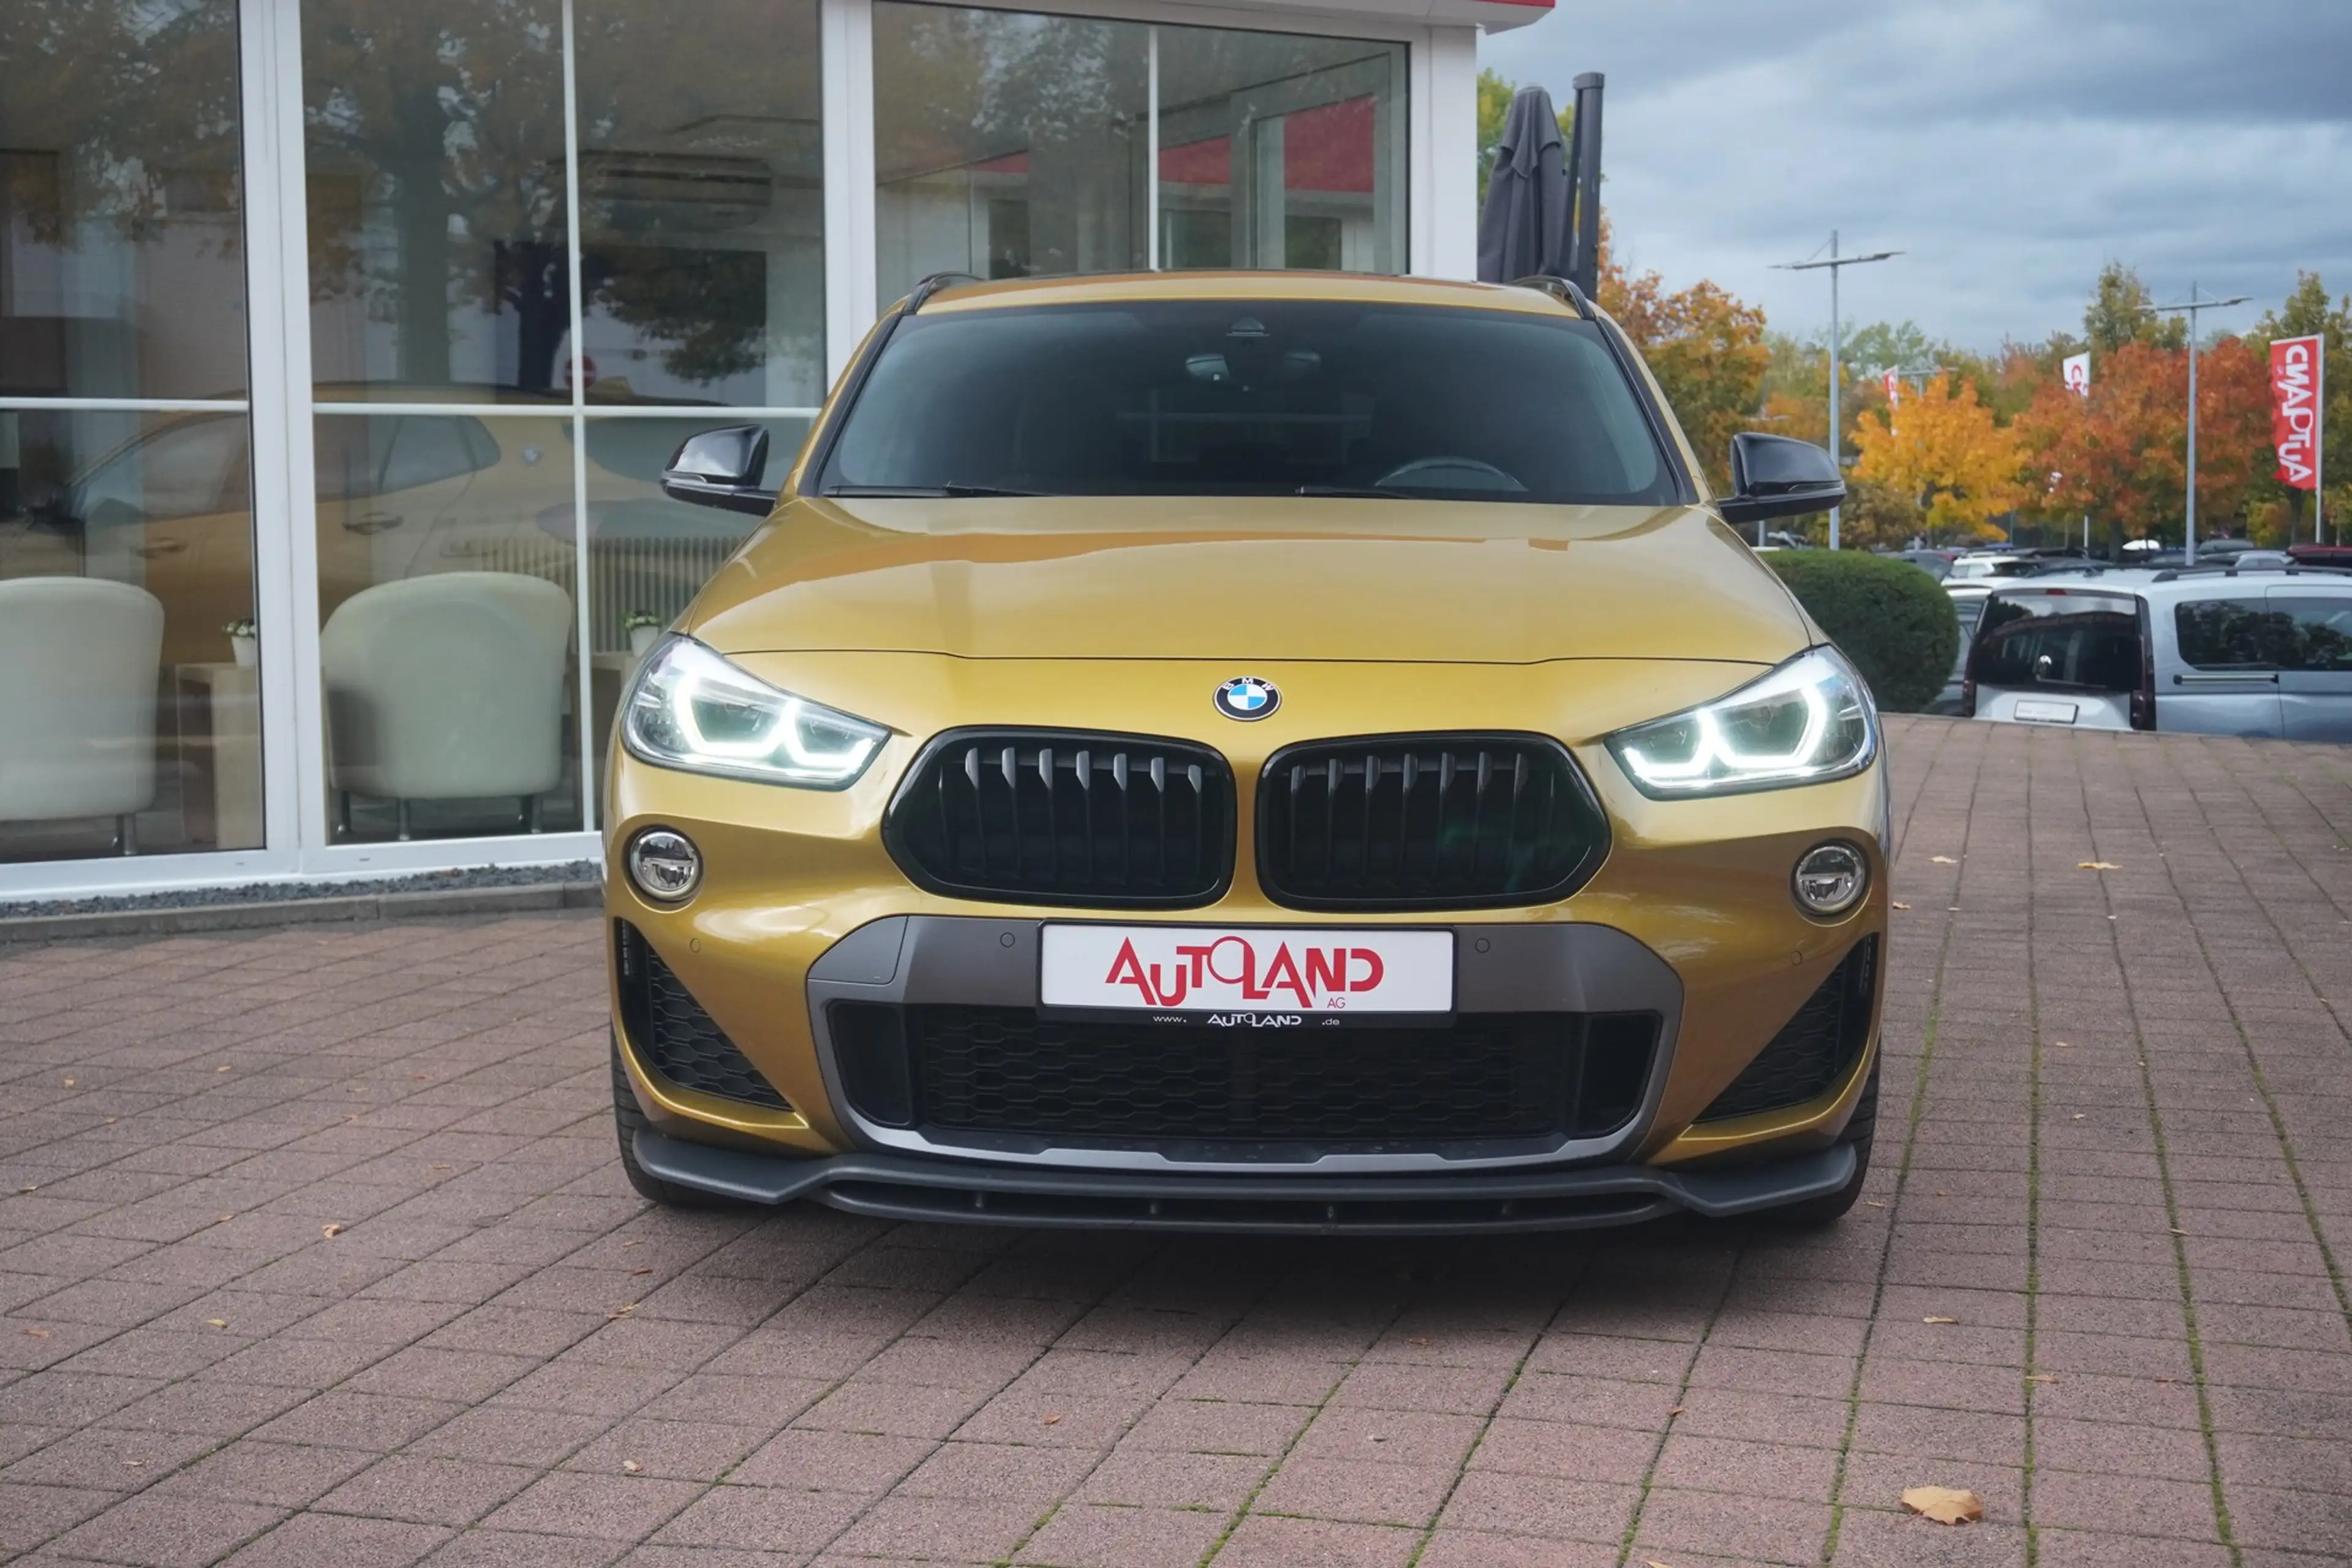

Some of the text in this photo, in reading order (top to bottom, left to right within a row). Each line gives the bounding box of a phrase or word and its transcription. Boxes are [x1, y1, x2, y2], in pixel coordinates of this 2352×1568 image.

[1222, 677, 1274, 691] BMW
[1105, 936, 1384, 1008] AUTOLAND
[1327, 998, 1346, 1009] AG
[1207, 1012, 1302, 1028] AUTOLAND
[1321, 1017, 1340, 1026] .de
